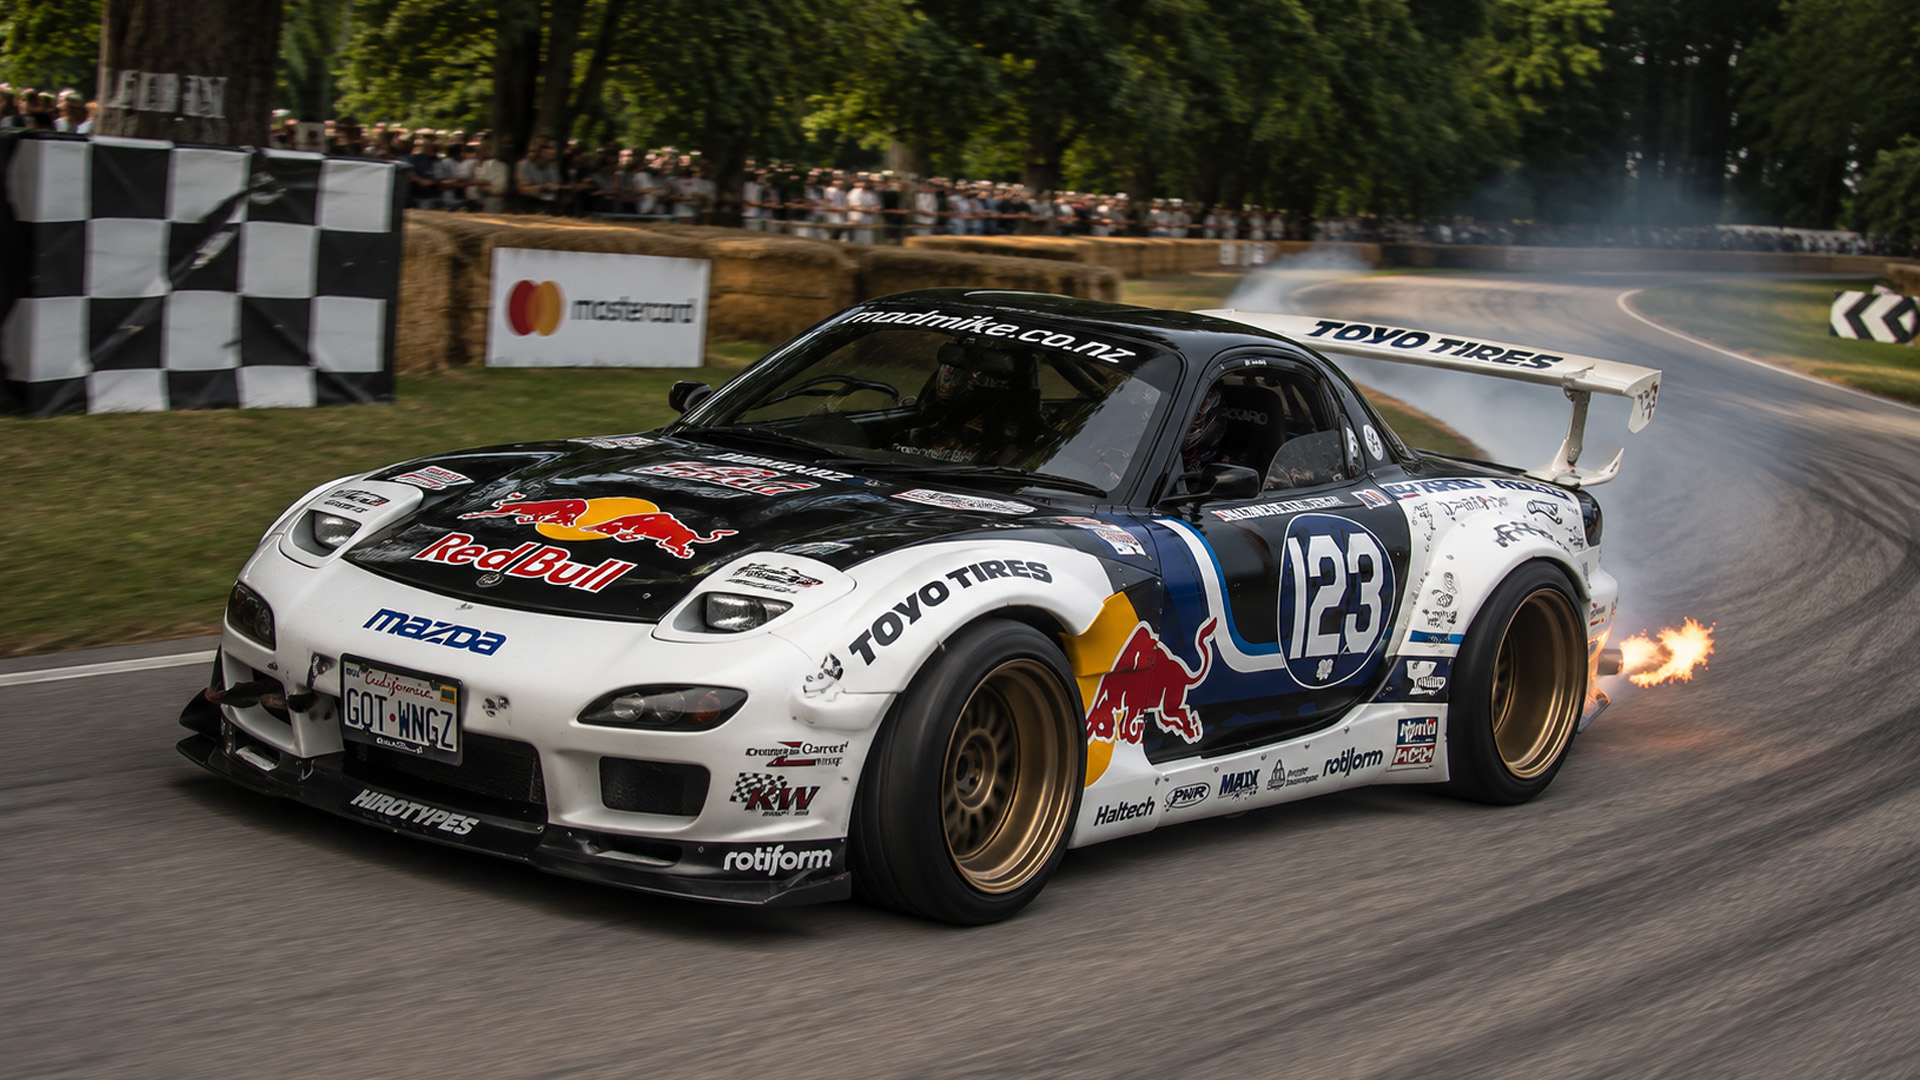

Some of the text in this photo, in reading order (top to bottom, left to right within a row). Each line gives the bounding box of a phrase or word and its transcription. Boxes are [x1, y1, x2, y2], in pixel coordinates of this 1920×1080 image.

[841, 309, 1136, 364] madmike.co.nz
[1304, 320, 1564, 370] TOYO TIRES
[411, 532, 638, 594] Red Bull
[848, 560, 1053, 666] TOYO TIRES
[1287, 532, 1384, 660] 123
[362, 608, 507, 656] mazda
[350, 788, 480, 835] HIROTYPES
[744, 785, 821, 811] KW
[1093, 796, 1156, 827] Haltech
[723, 844, 833, 876] rotiform
